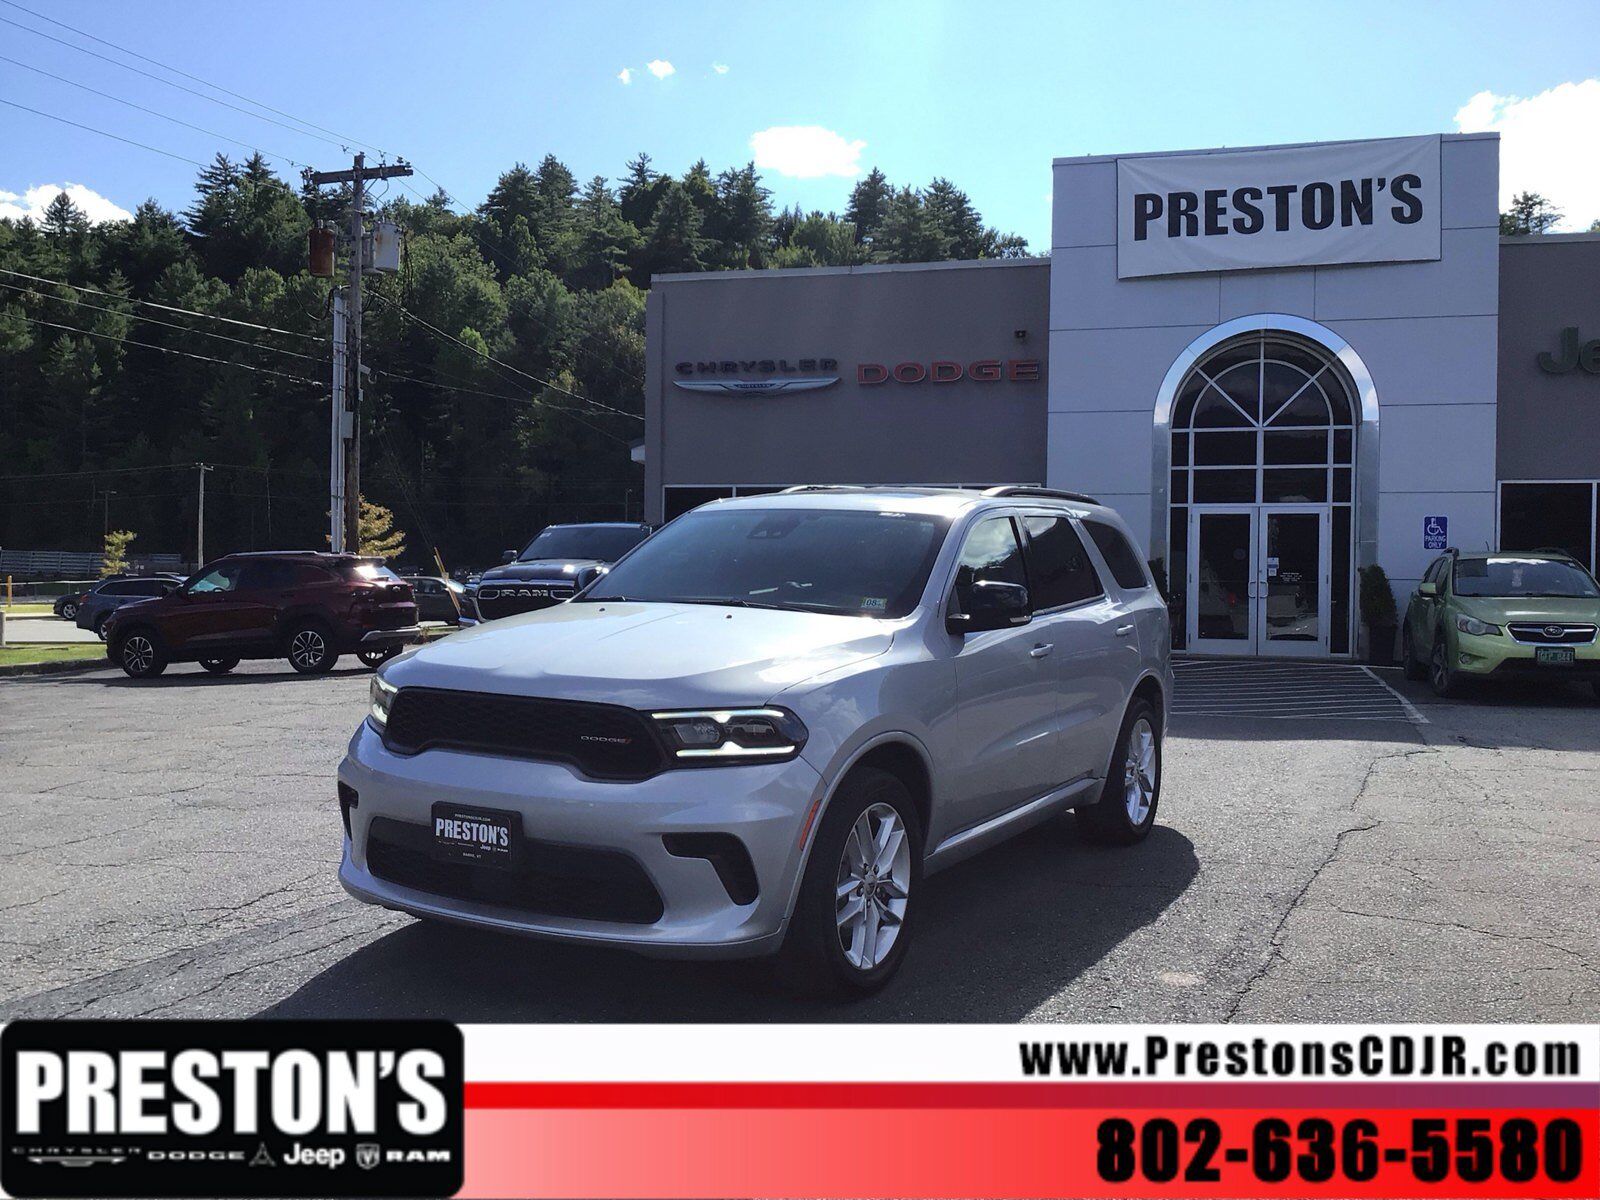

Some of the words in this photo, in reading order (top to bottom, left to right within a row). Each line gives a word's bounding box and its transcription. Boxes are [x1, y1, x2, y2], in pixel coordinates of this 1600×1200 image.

[1134, 173, 1423, 241] PRESTON'S
[675, 357, 838, 376] CHRYSLER
[857, 359, 1040, 384] DODGE
[1425, 535, 1446, 543] PARKING
[501, 589, 549, 597] RAM
[580, 735, 626, 743] DODGE
[435, 818, 508, 846] PRESTON'S
